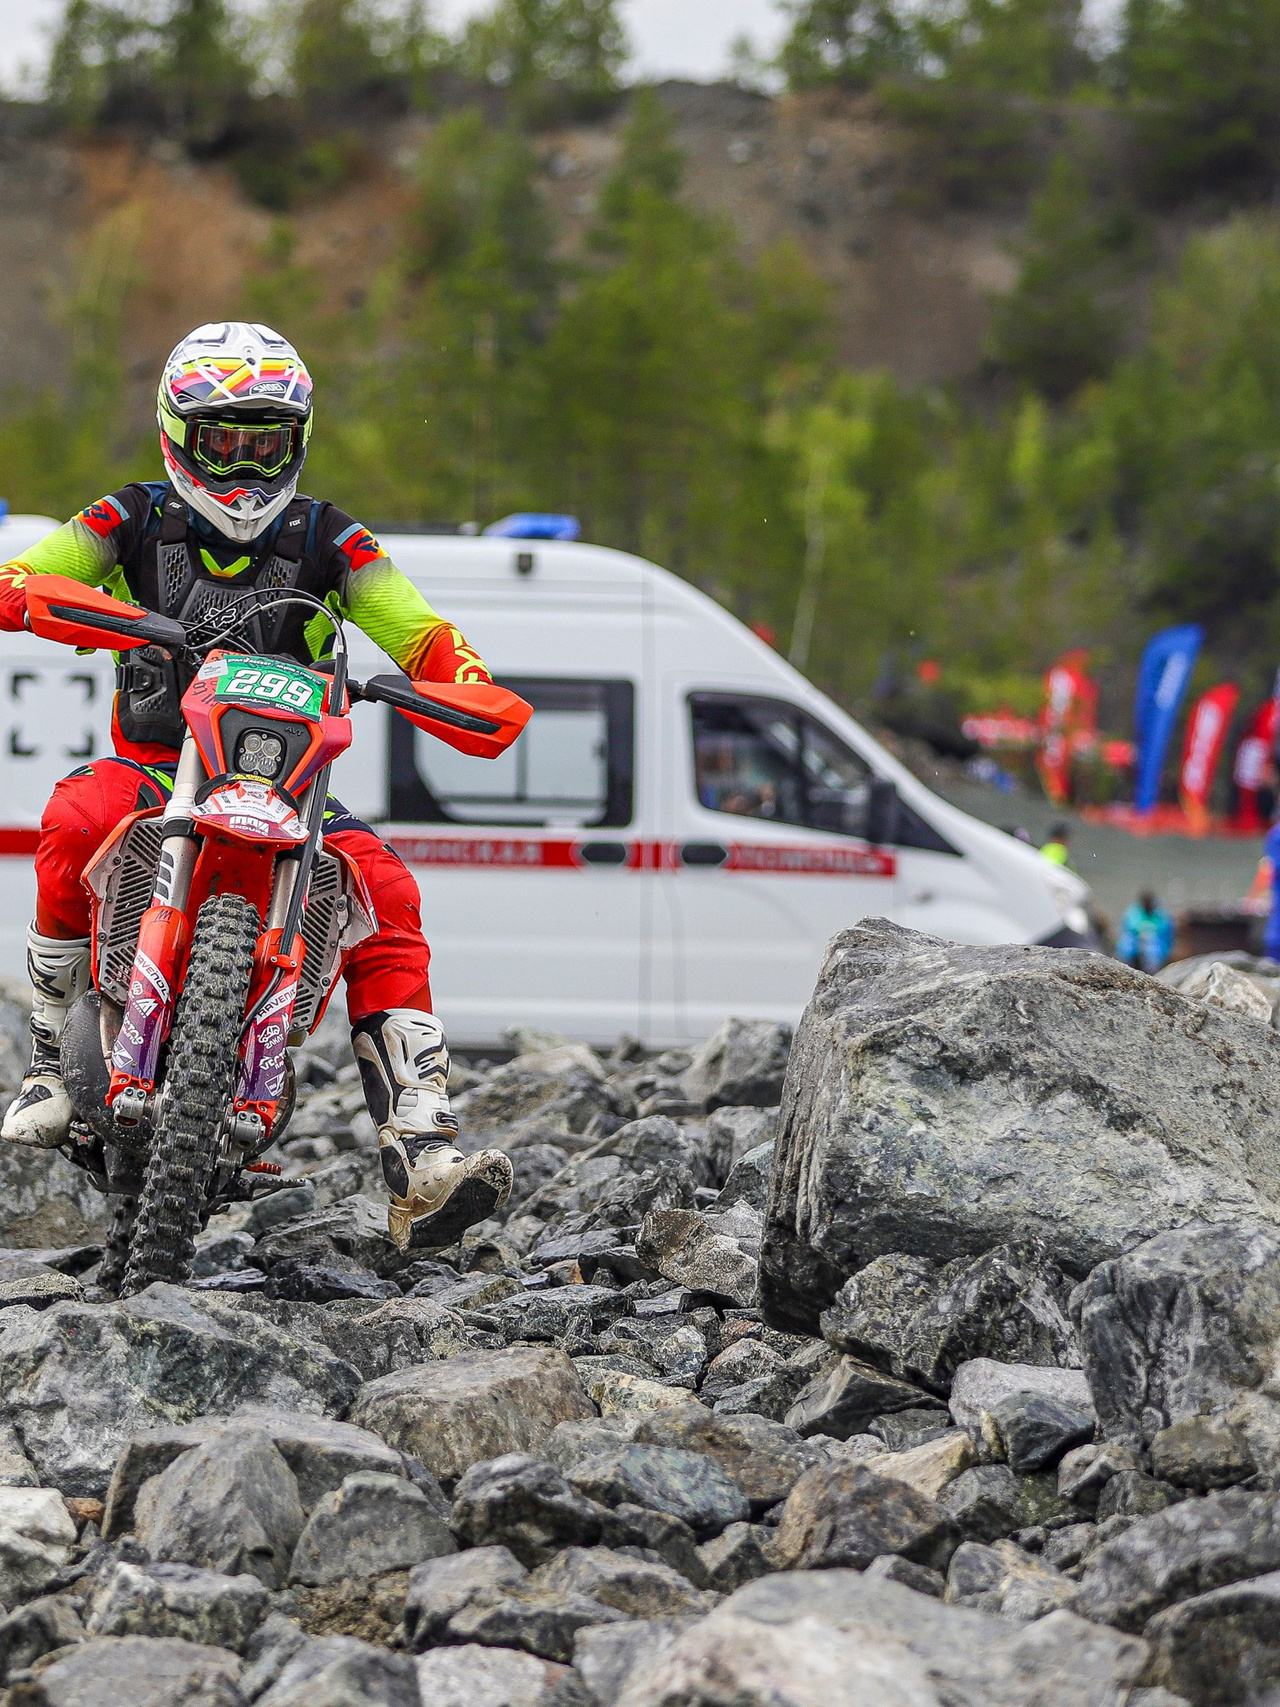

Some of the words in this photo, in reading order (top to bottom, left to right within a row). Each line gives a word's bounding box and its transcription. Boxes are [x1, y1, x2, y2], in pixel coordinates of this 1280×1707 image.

[253, 382, 283, 392] SHOEI
[289, 518, 301, 527] FOX
[225, 669, 313, 708] 299
[136, 955, 168, 996] AVENOL
